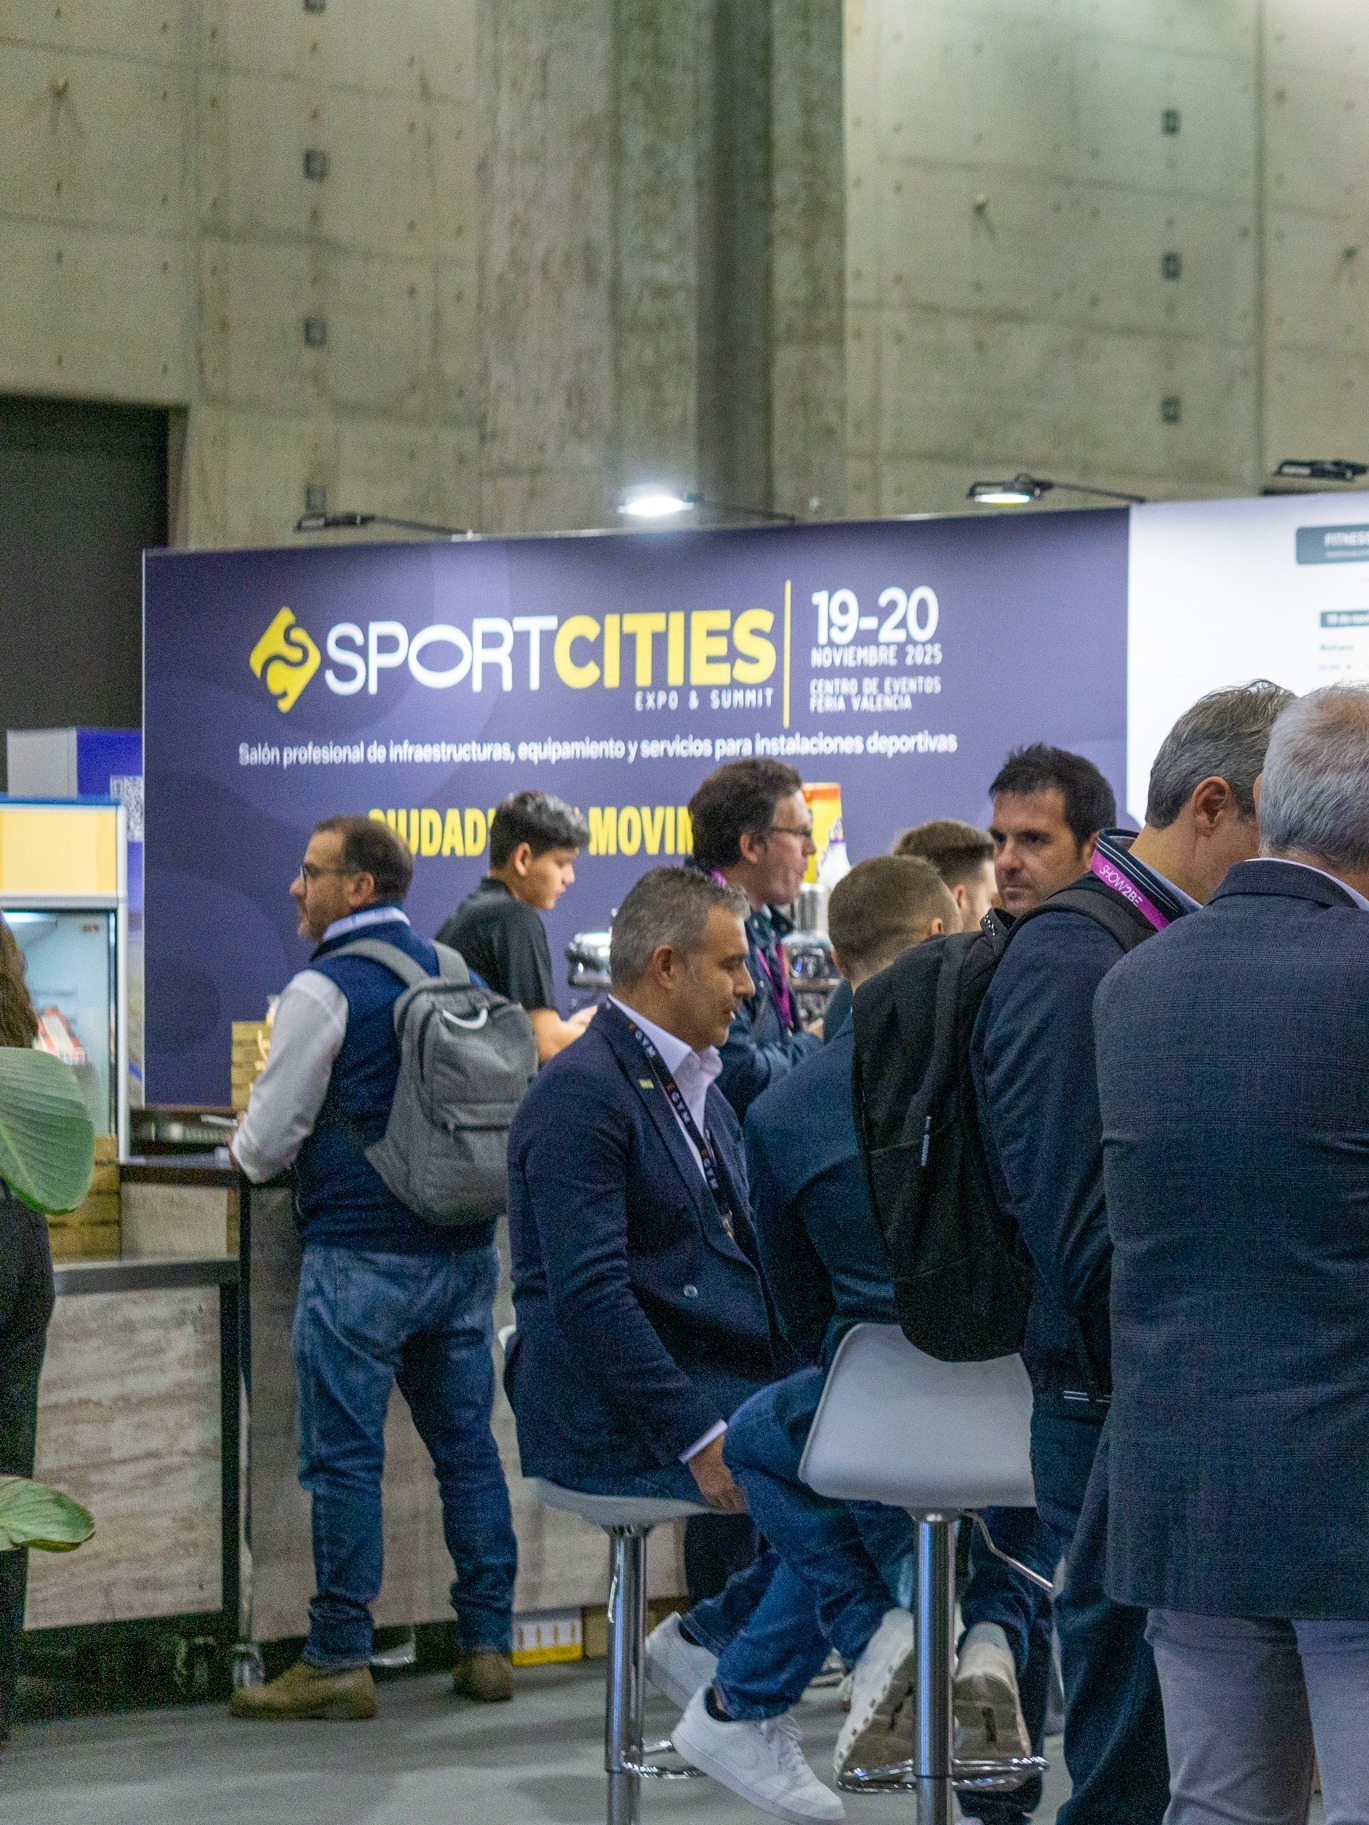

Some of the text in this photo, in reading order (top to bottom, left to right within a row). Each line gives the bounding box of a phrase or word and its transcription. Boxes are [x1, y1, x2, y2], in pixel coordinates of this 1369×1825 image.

[811, 584, 940, 646] 19-20
[324, 608, 776, 696] SPORTCITIES
[811, 643, 943, 668] NOVIEMBRE 2025
[634, 691, 678, 711] EXPO
[711, 688, 774, 709] SUMMIT
[809, 676, 942, 696] CENTRO DE EVENTOS
[809, 693, 912, 713] FERIA VALENCIA
[239, 730, 959, 770] Salón profesional de infraestructuras, equipamiento y servicios para instalaciones deportivas
[1099, 864, 1143, 907] SHOW2BE
